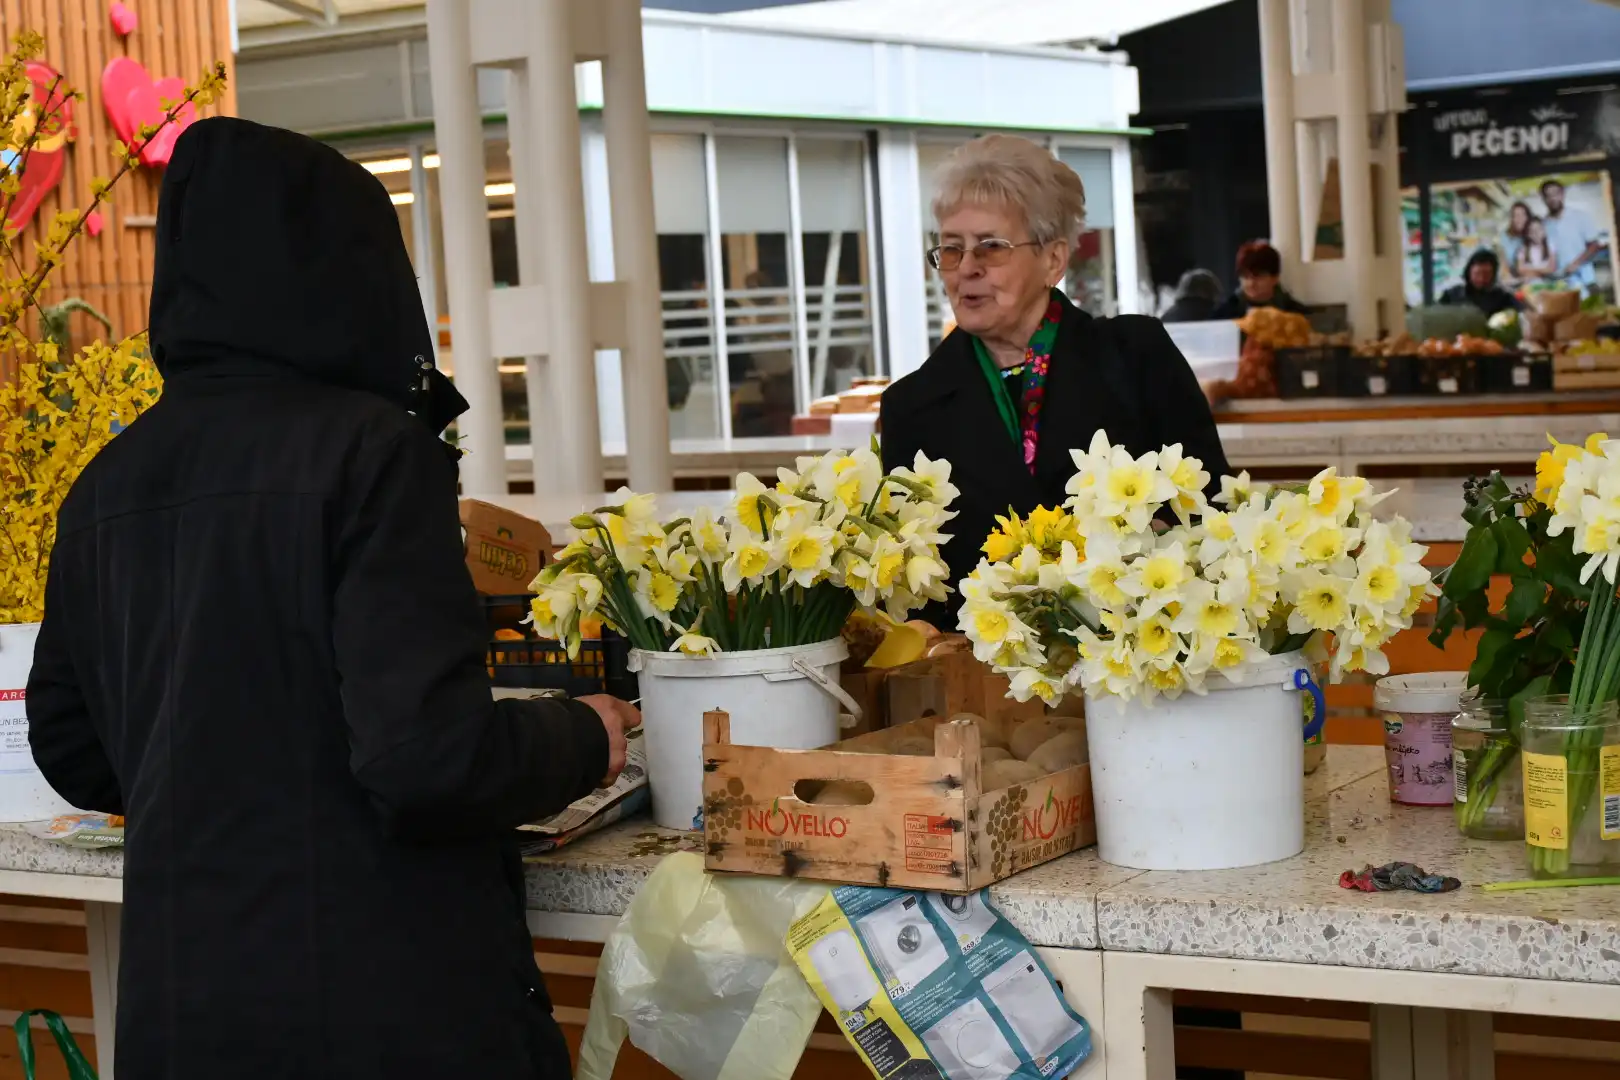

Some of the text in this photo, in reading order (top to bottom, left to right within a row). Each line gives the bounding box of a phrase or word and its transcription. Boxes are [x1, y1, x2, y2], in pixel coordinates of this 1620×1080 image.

[1451, 119, 1569, 158] PEČENO!
[1392, 744, 1420, 756] mlijeko
[747, 806, 848, 838] NOVELLO
